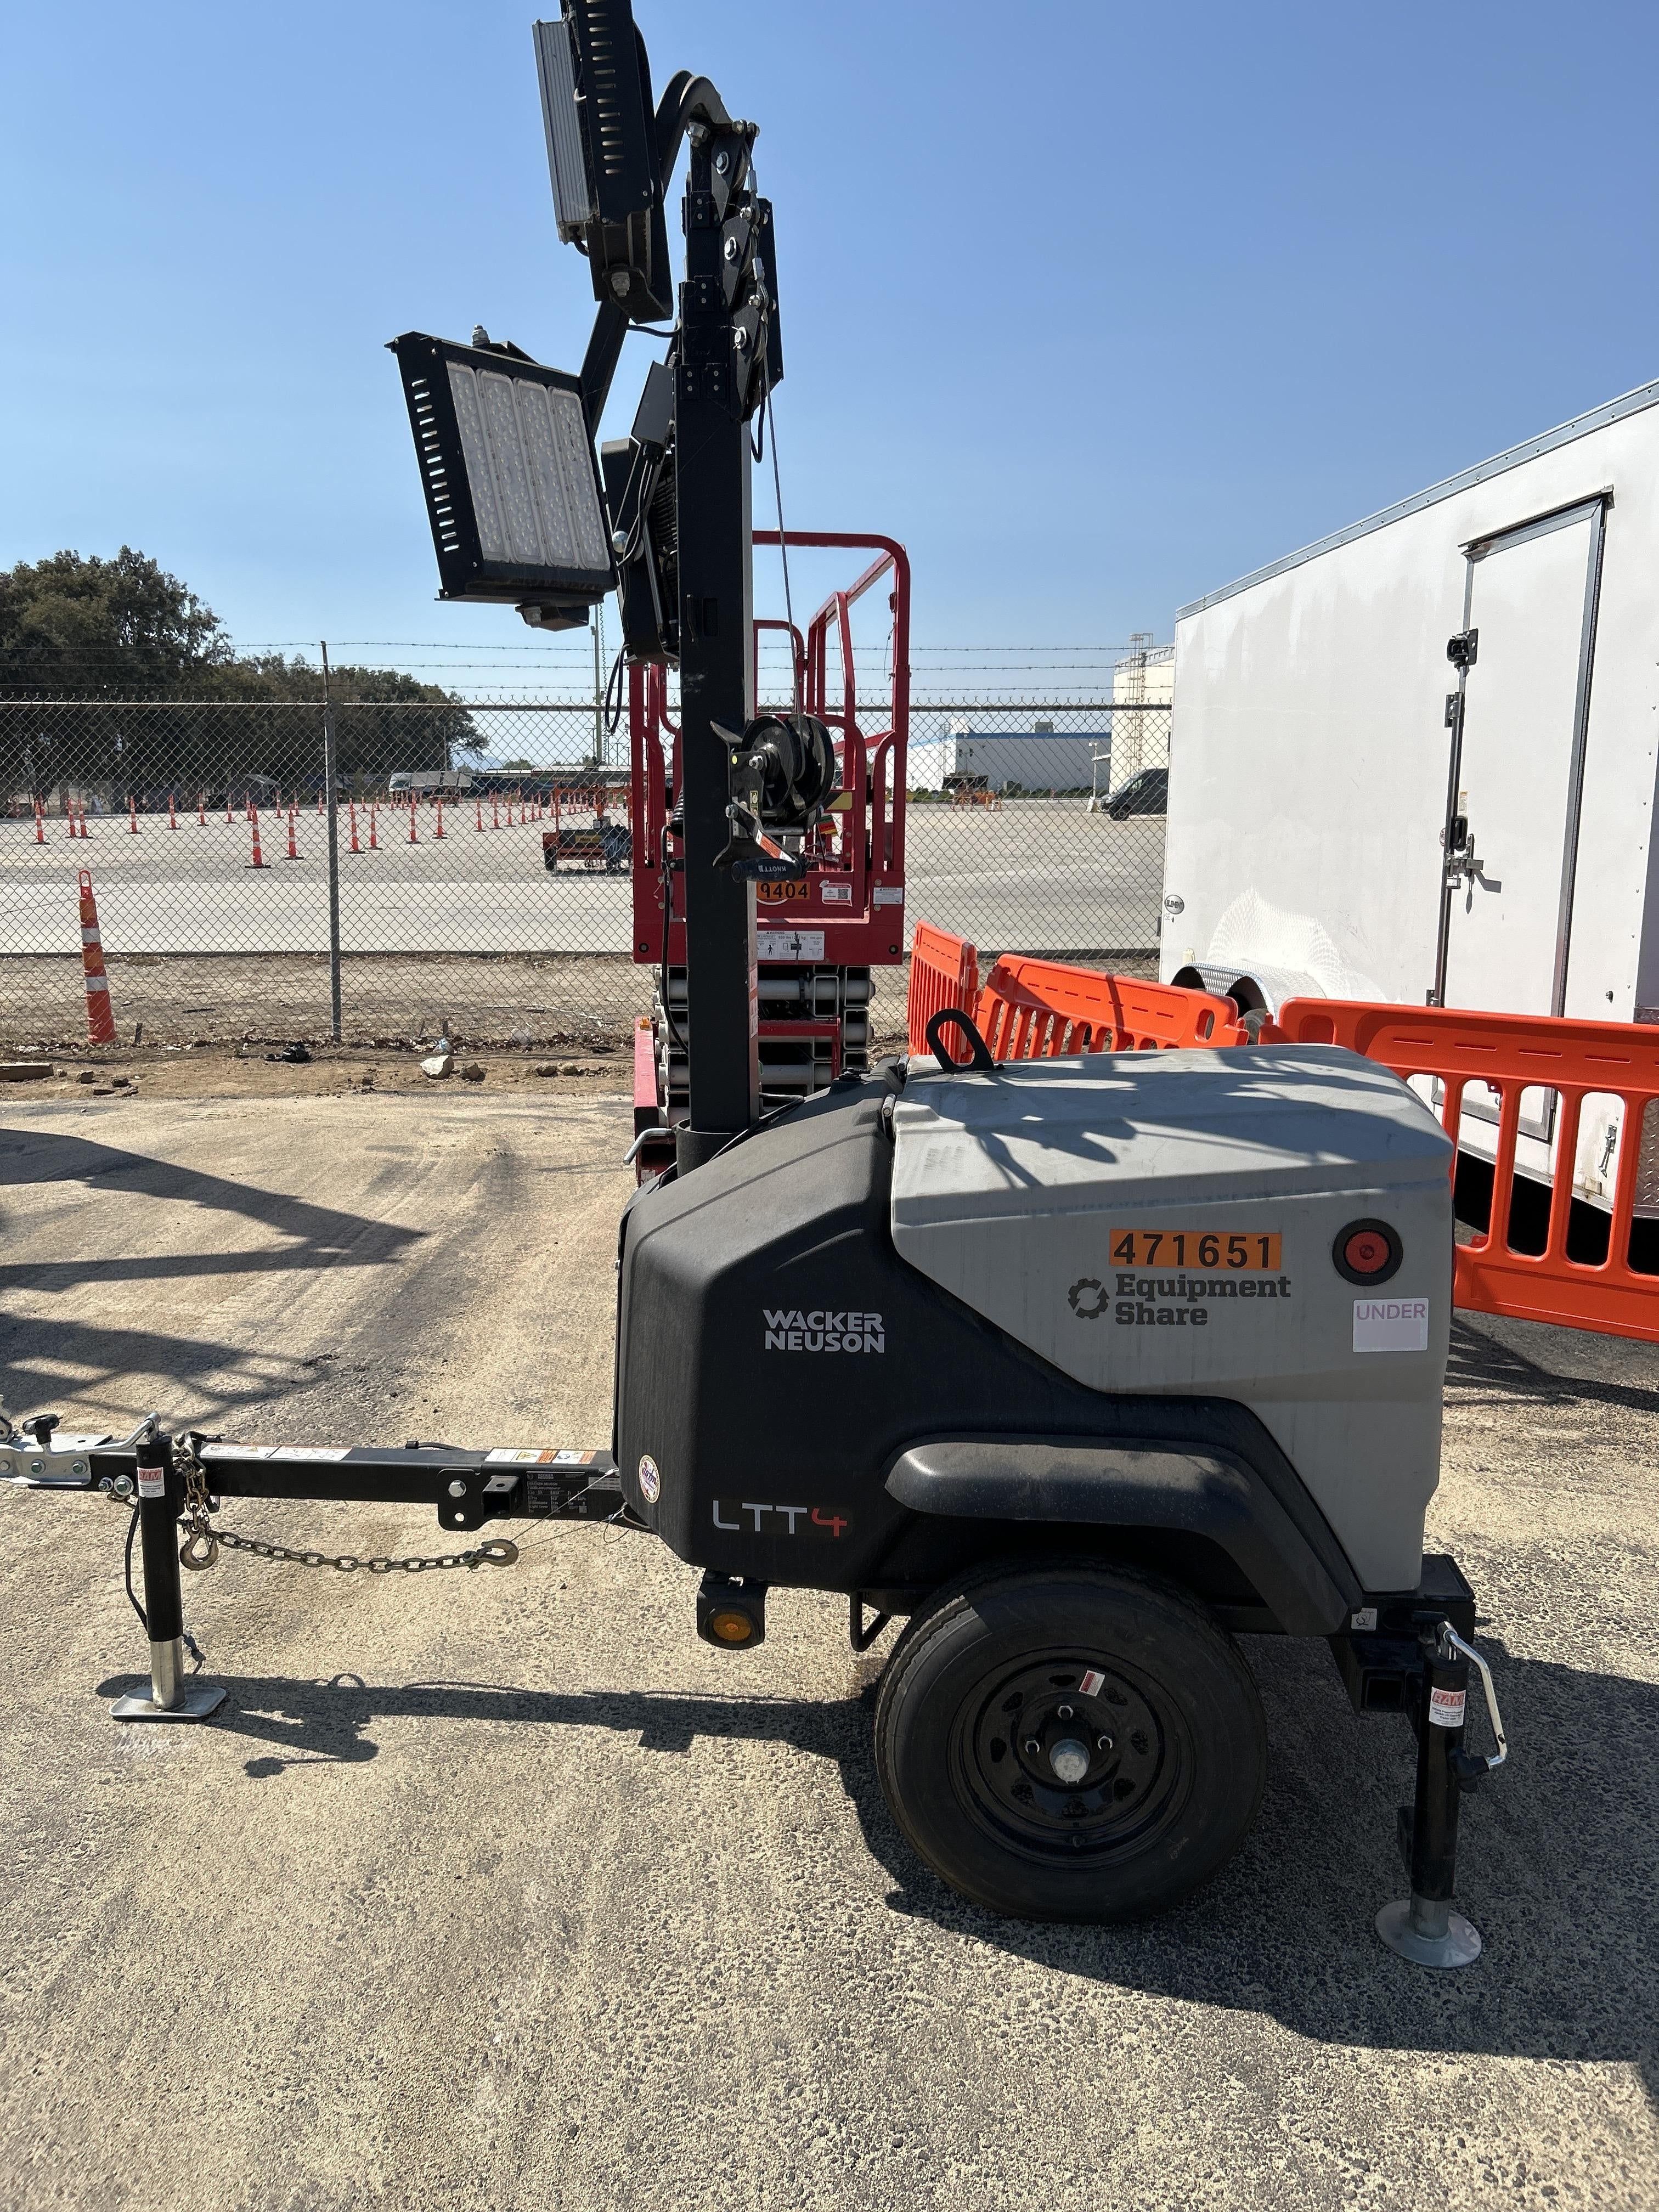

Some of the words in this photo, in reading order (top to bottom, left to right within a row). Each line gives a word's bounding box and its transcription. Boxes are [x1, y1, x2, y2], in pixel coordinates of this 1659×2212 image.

[1114, 1233, 1269, 1268] 471651
[1116, 1273, 1291, 1302] Equipment
[763, 1309, 885, 1332] WACKER
[1115, 1302, 1207, 1325] Share
[1356, 1304, 1426, 1320] UNDER
[765, 1330, 885, 1353] NEUSON
[712, 1499, 847, 1537] LTT4
[1433, 1693, 1464, 1706] RAM
